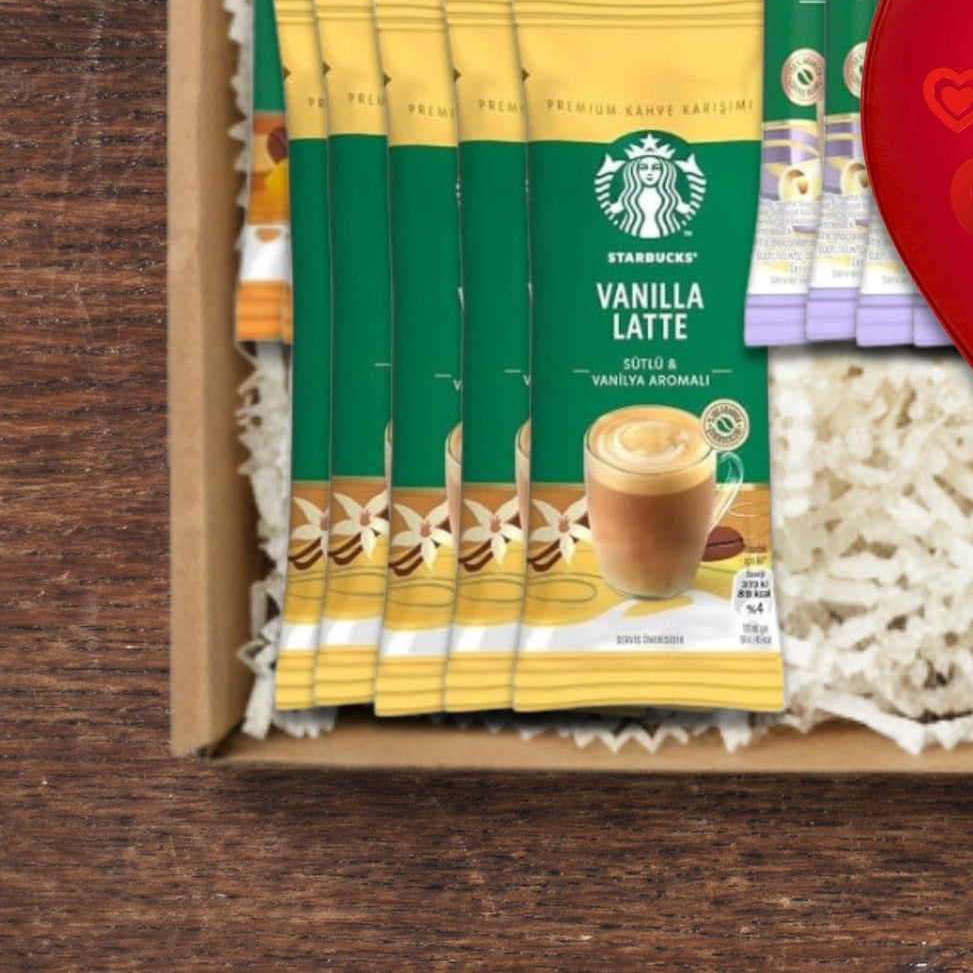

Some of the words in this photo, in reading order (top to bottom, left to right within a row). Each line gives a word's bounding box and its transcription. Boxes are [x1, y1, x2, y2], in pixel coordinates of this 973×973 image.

[546, 99, 616, 116] PREMIUM
[625, 105, 675, 117] KAHVE
[596, 282, 704, 310] VANILLA
[613, 313, 688, 340] LATTE
[623, 356, 664, 371] SÜTLÜ
[667, 358, 677, 370] &
[592, 372, 645, 387] VANİLYA
[650, 374, 710, 387] AROMALI
